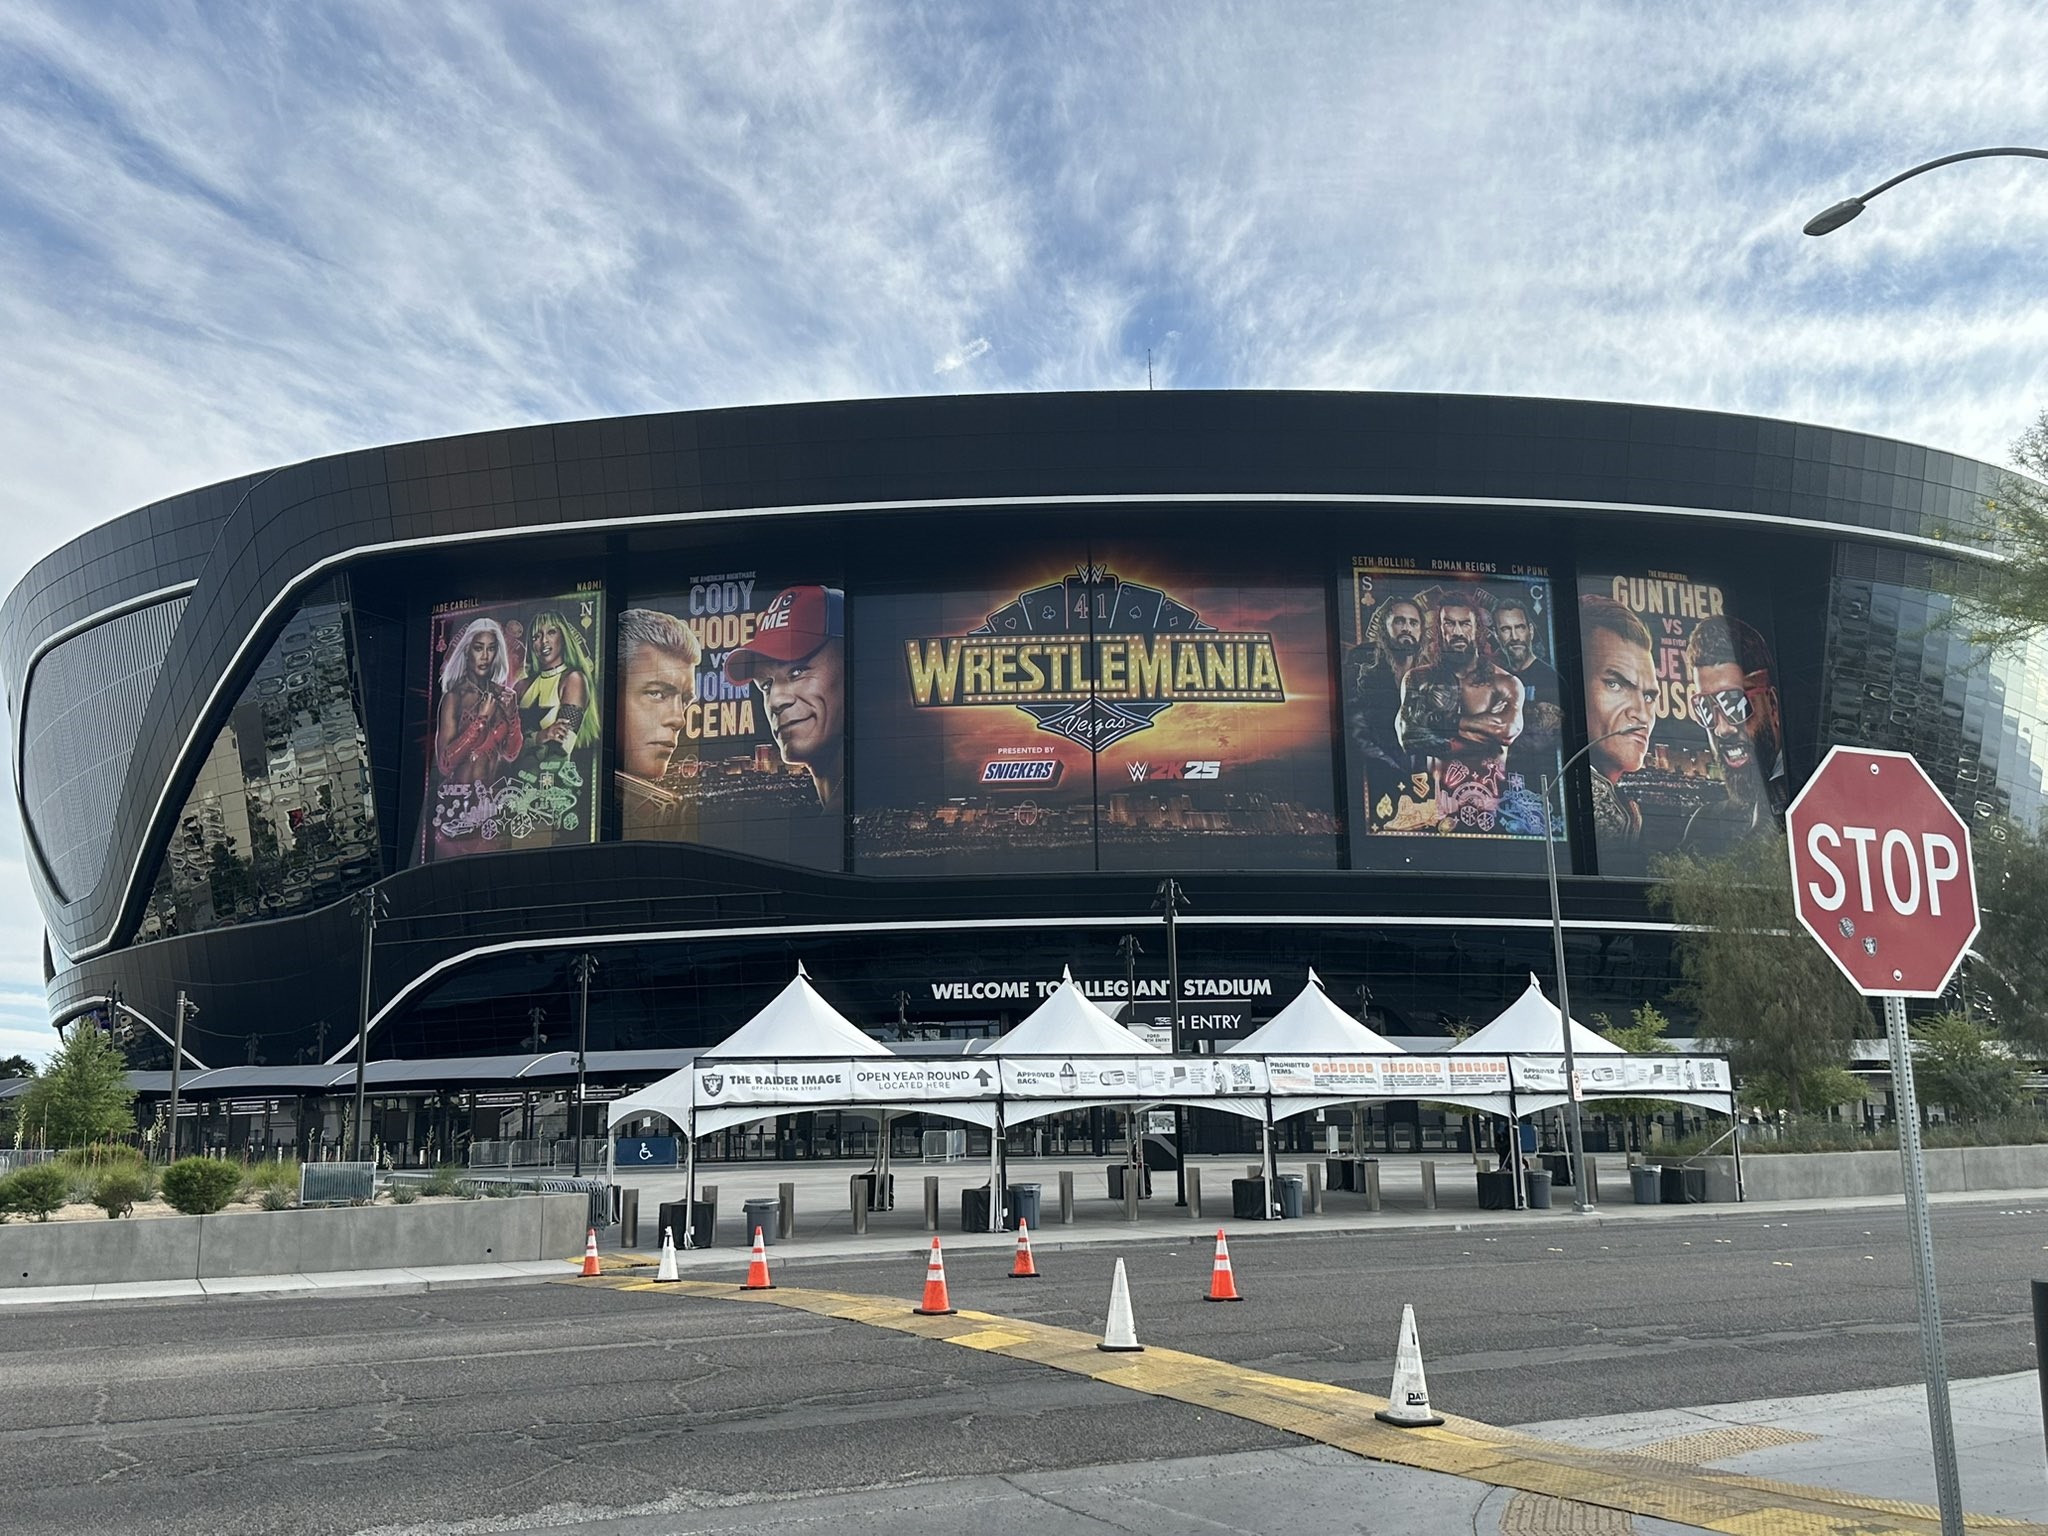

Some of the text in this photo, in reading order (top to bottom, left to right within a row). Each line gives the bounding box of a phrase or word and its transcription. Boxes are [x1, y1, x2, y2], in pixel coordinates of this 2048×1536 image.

[1352, 556, 1416, 568] SETH ROLLINS
[1431, 560, 1497, 572] ROMAN REIGNS
[1511, 565, 1549, 576] CM PUNK
[576, 580, 602, 591] NAOMI
[690, 580, 755, 616] CODY
[1074, 593, 1107, 619] 41
[1613, 576, 1724, 619] GUNTHER
[432, 598, 479, 615] JADE CARGILL
[689, 611, 764, 651] HODE
[1662, 618, 1683, 635] VS
[686, 700, 755, 739] CENA
[1060, 715, 1127, 737] Vegas
[998, 747, 1043, 755] PRESENTED
[986, 761, 1053, 779] SNICKERS
[1807, 823, 1959, 916] STOP
[931, 978, 1272, 1000] WELCOME TO ALLEGIAN STADIUM
[1191, 1014, 1241, 1030] ENTRY
[729, 1074, 841, 1085] THE RAIDER IMAGE
[857, 1070, 970, 1081] OPEN YEAR ROUND
[879, 1081, 951, 1090] LOCATED HERE
